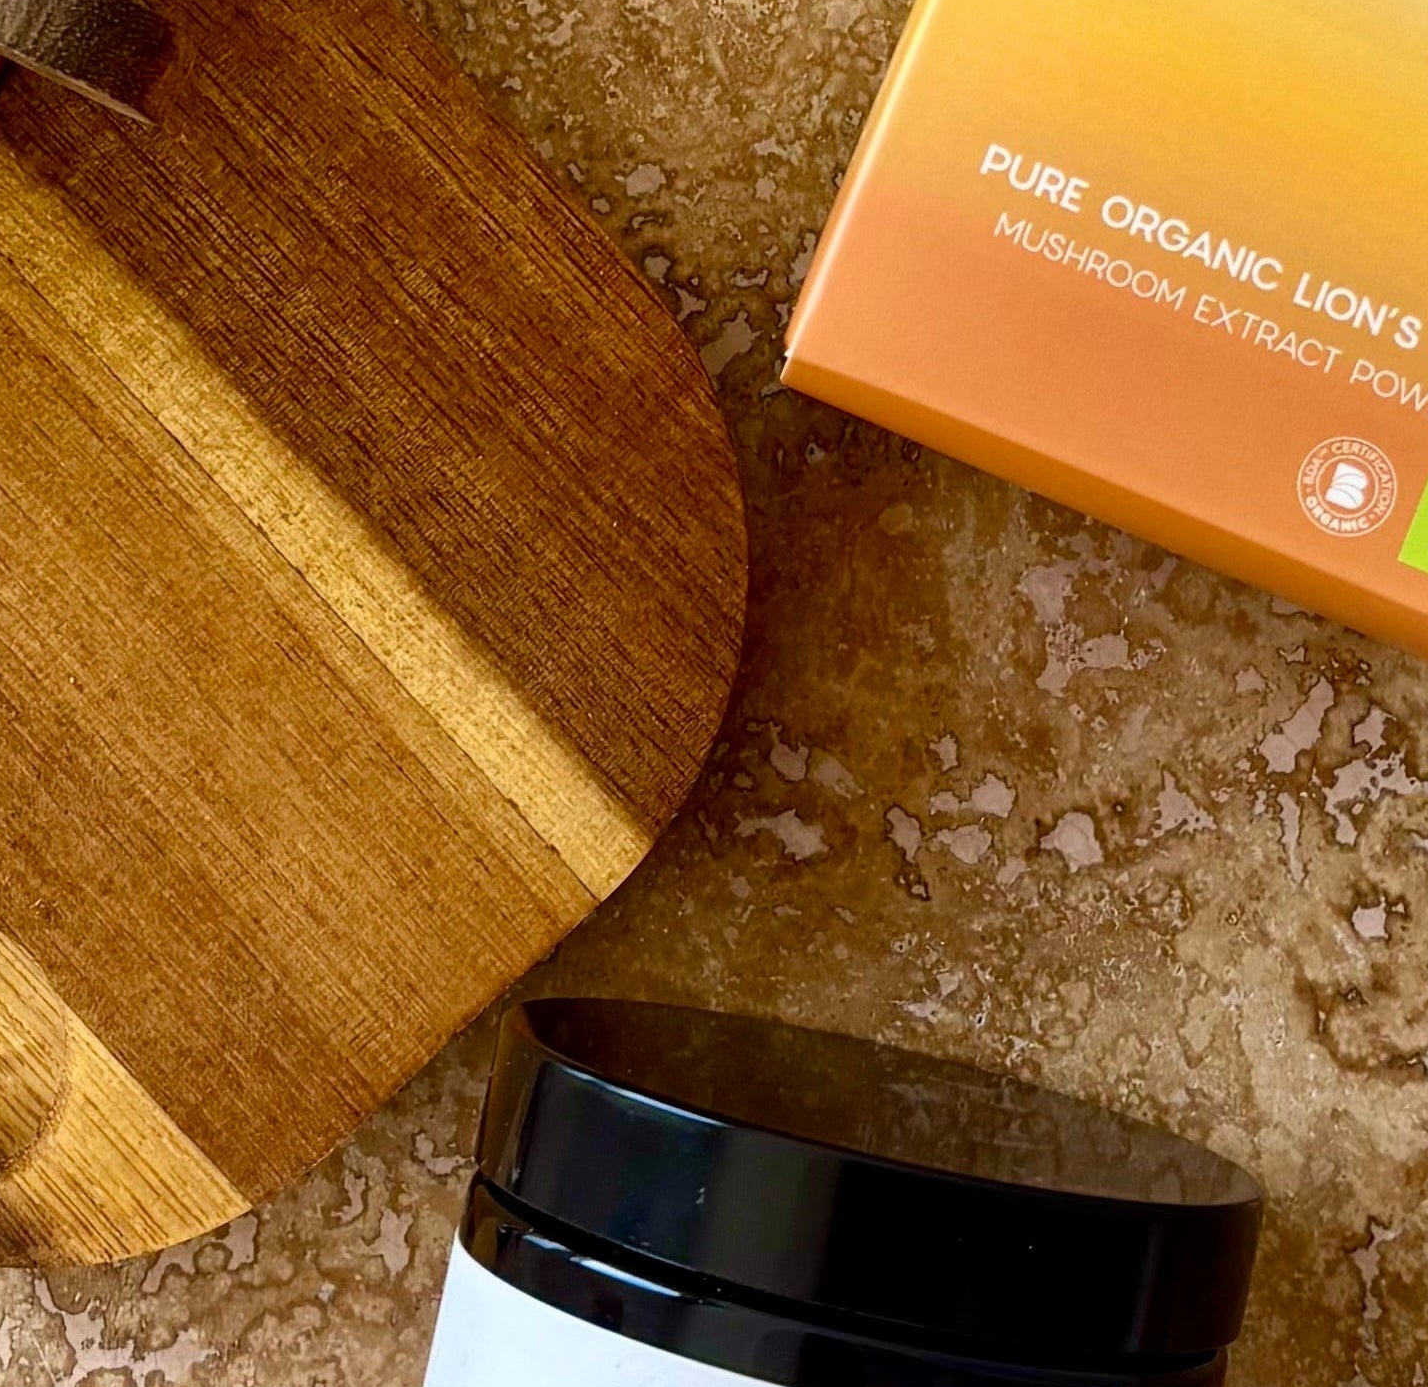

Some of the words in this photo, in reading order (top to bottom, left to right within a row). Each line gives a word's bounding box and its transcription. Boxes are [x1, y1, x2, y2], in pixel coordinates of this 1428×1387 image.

[980, 143, 1089, 213] PURE
[1101, 195, 1283, 290] ORGANIC
[1293, 273, 1422, 349] LION'S
[993, 212, 1187, 311] MUSHROOM
[1193, 294, 1343, 374] EXTRACT
[1306, 496, 1369, 531] ORGANIC
